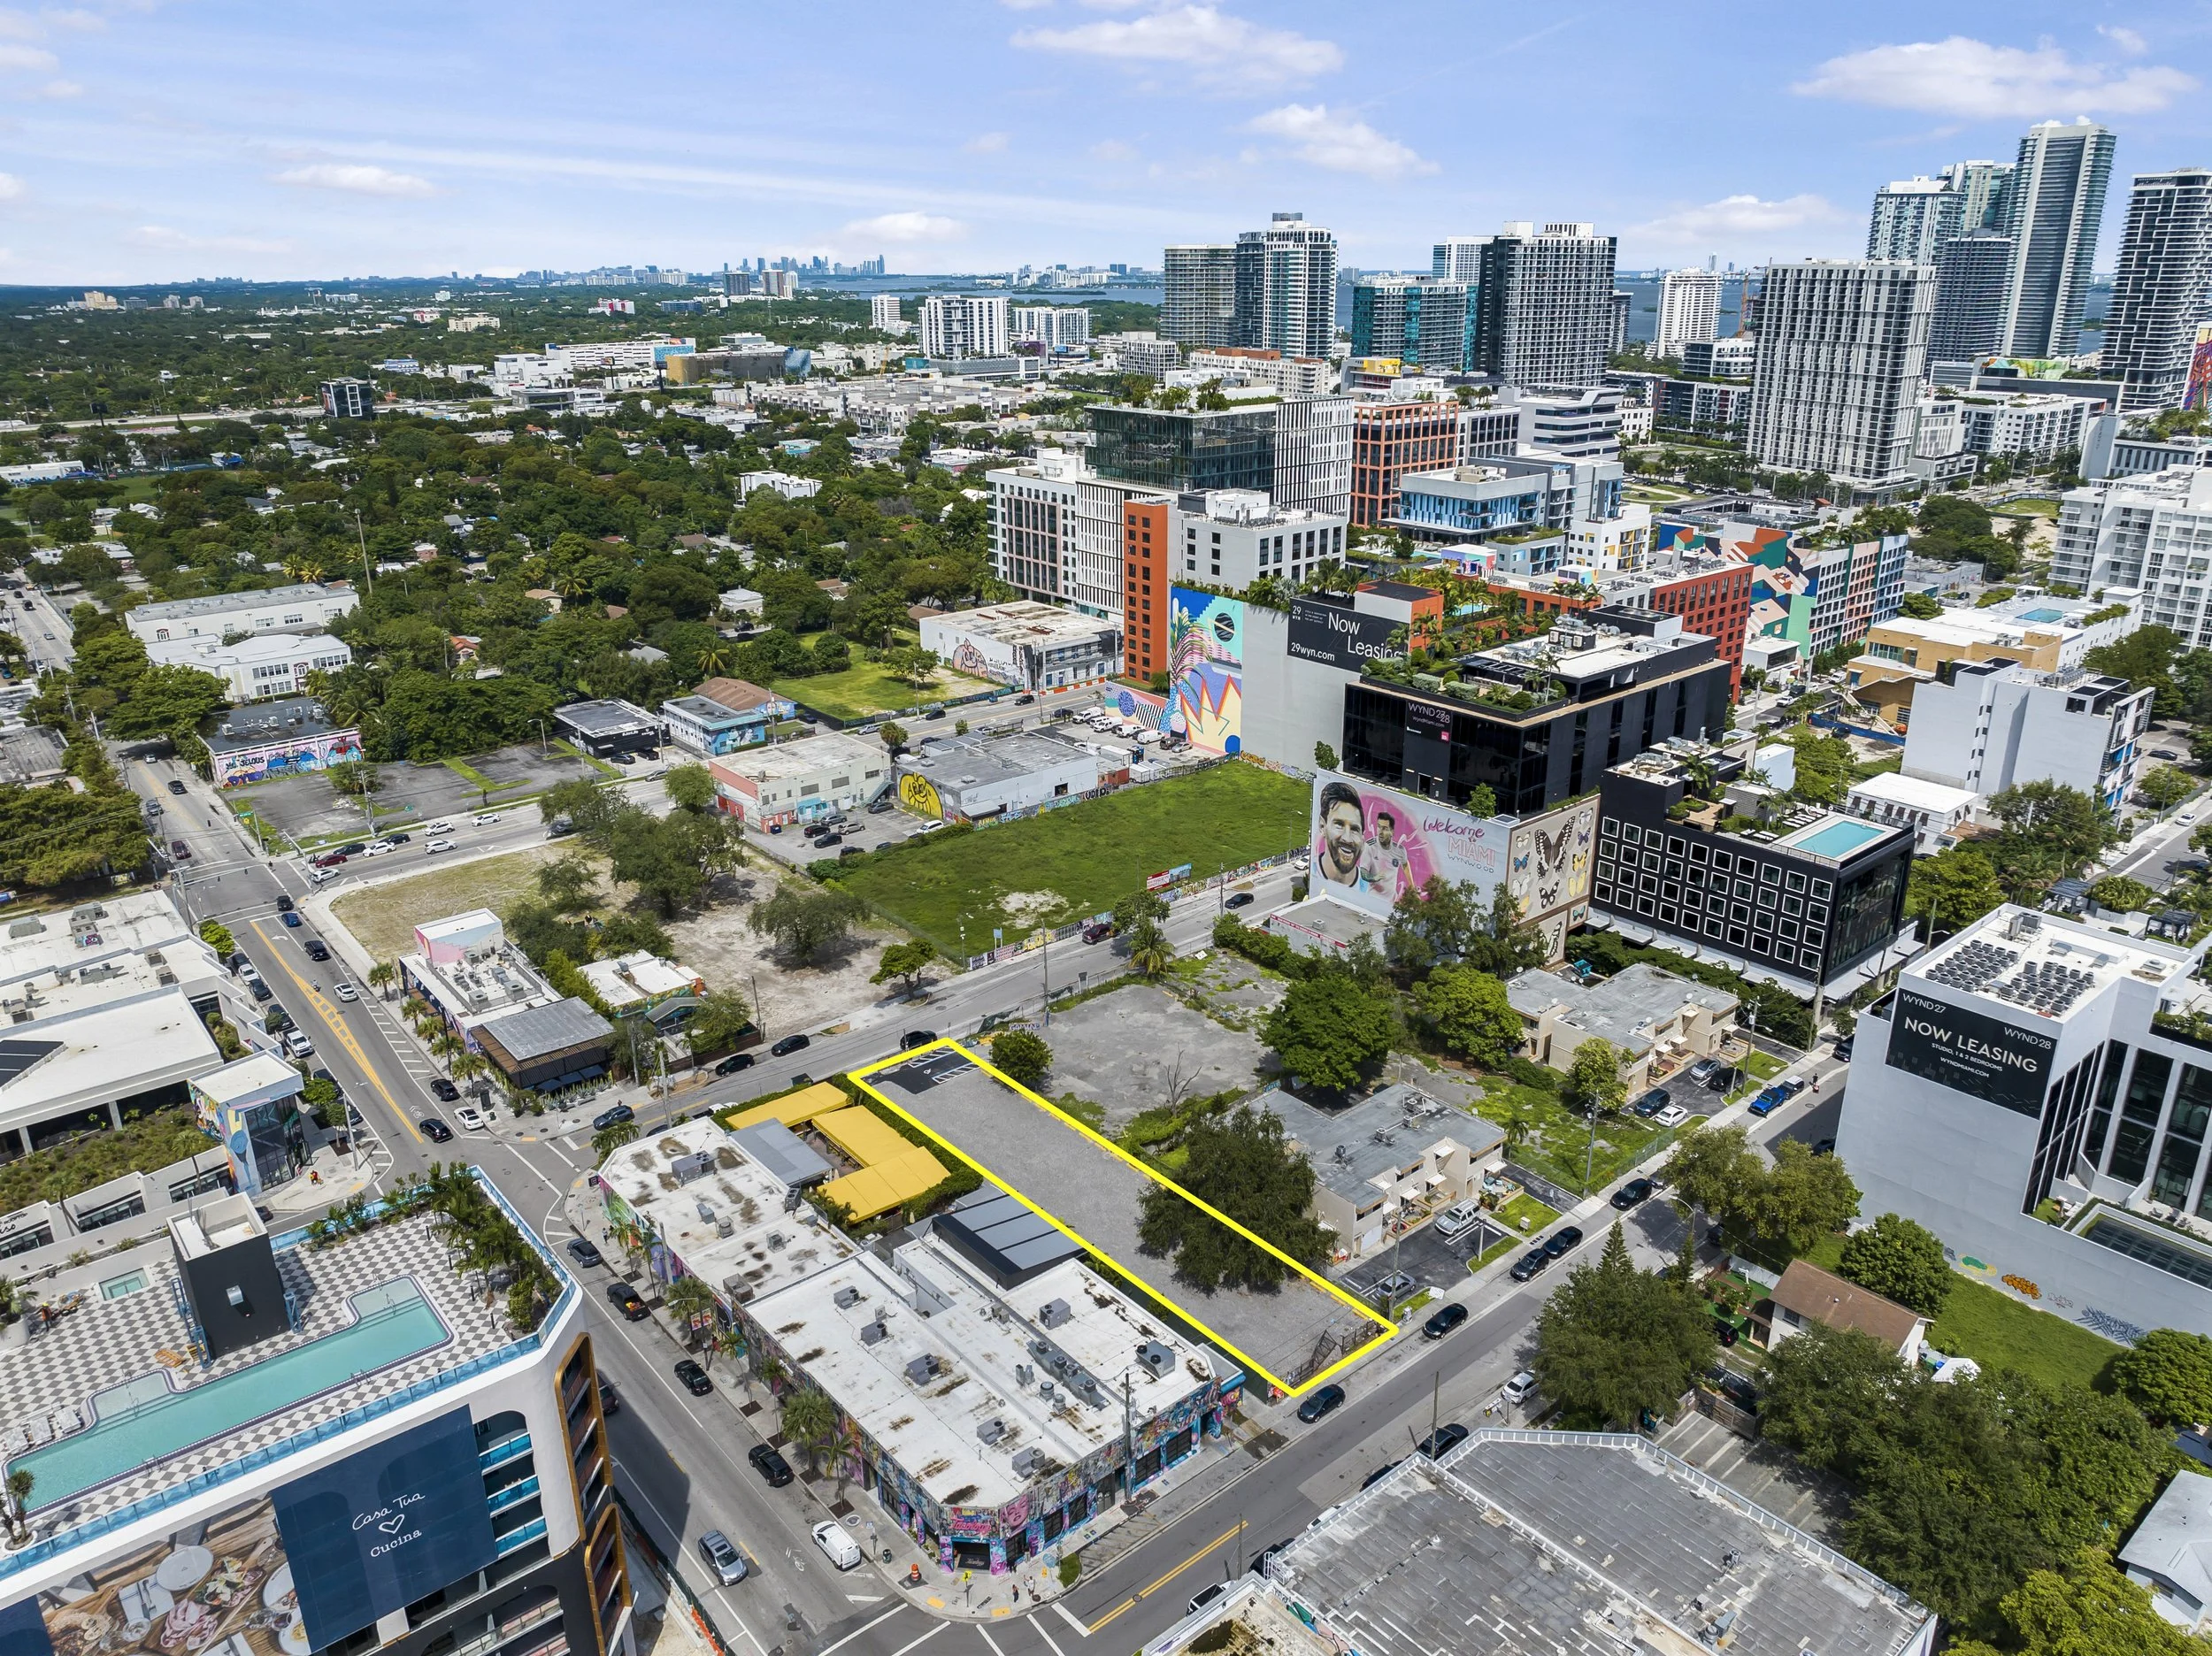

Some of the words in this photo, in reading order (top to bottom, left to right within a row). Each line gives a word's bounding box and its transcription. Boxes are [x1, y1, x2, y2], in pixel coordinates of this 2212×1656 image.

[1293, 605, 1302, 615] 29
[1328, 612, 1360, 635] Now
[1291, 642, 1335, 662] 29wyn.com
[1423, 816, 1485, 838] Welcome
[1448, 835, 1495, 868] MIAMI
[1448, 854, 1494, 873] WYNWOOD
[1904, 1016, 1952, 1042] NOW
[1957, 1034, 2038, 1073] LEASING
[1932, 1042, 1954, 1056] STUDIO,
[1970, 1055, 2003, 1072] BEDROOMS
[352, 1507, 392, 1530] Casa
[392, 1492, 426, 1509] Tua
[370, 1530, 422, 1557] Cucina
